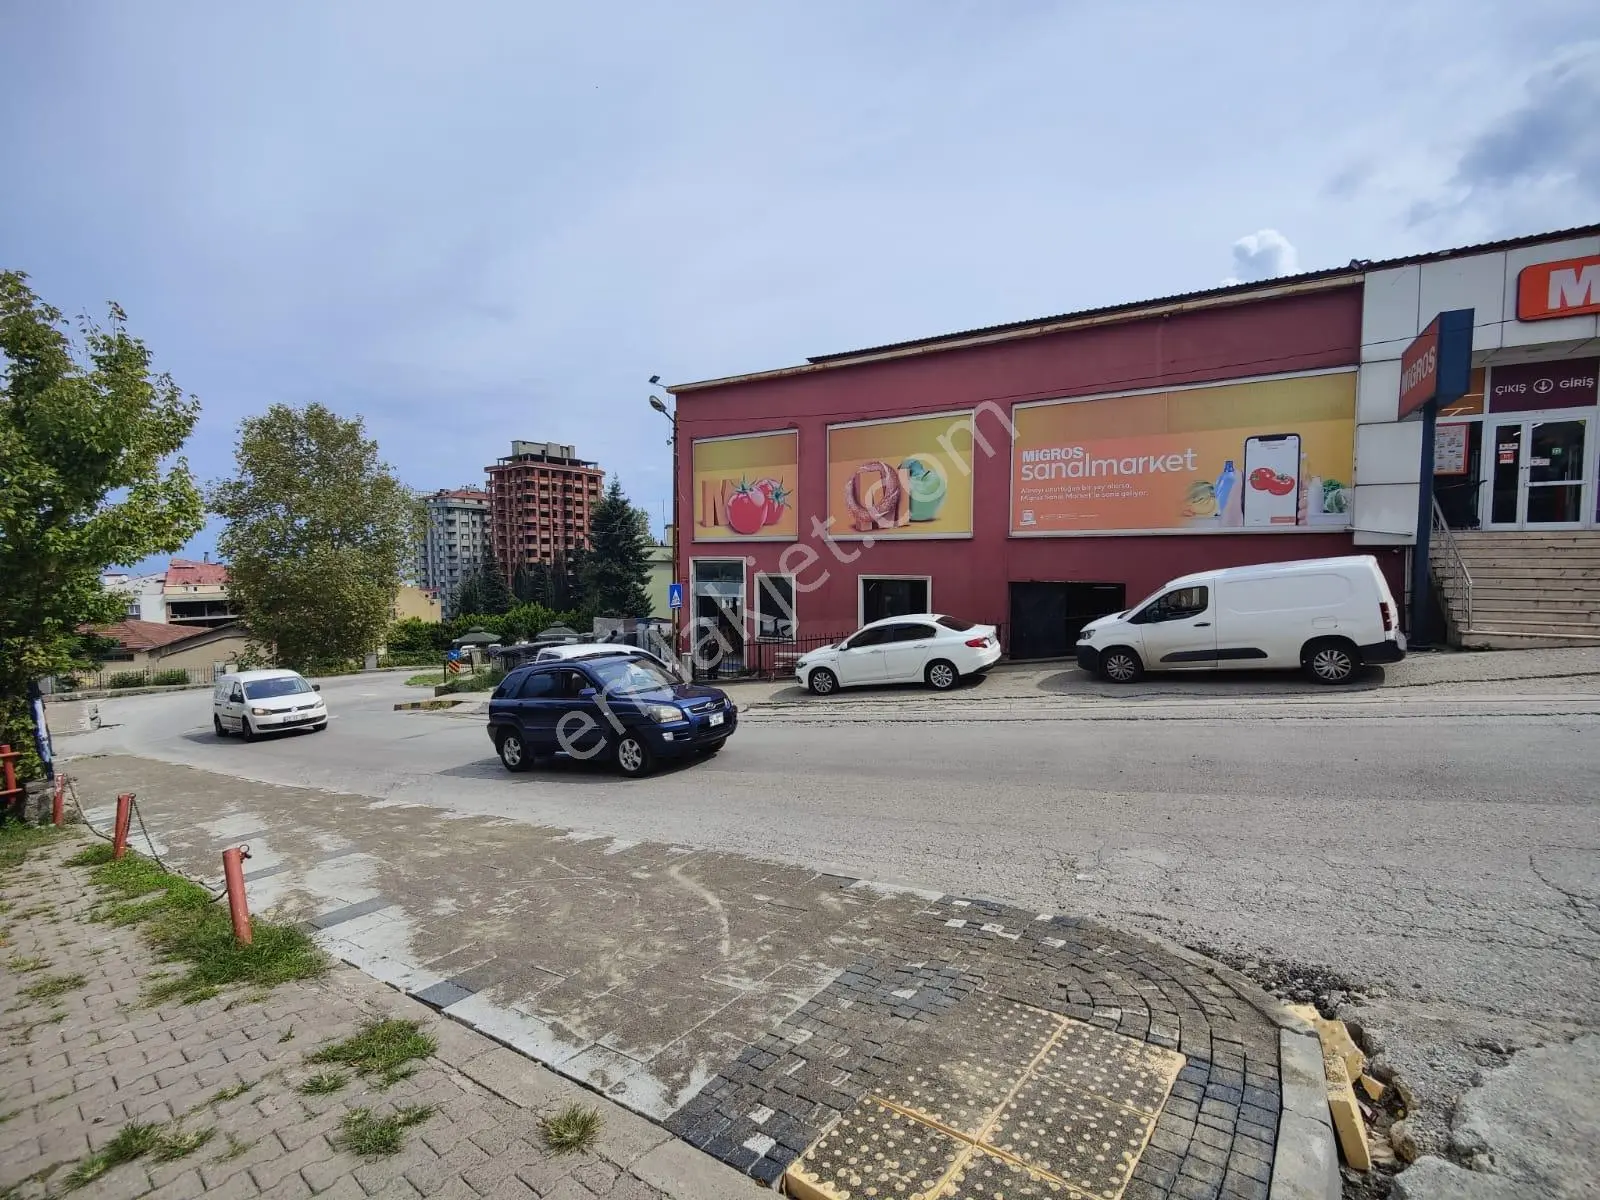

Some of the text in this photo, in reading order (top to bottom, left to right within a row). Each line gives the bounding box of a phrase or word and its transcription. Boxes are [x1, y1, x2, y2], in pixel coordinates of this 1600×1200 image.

[1495, 376, 1594, 395] ÇIKIŞ GİRİŞ
[1021, 448, 1198, 481] sanalmarket
